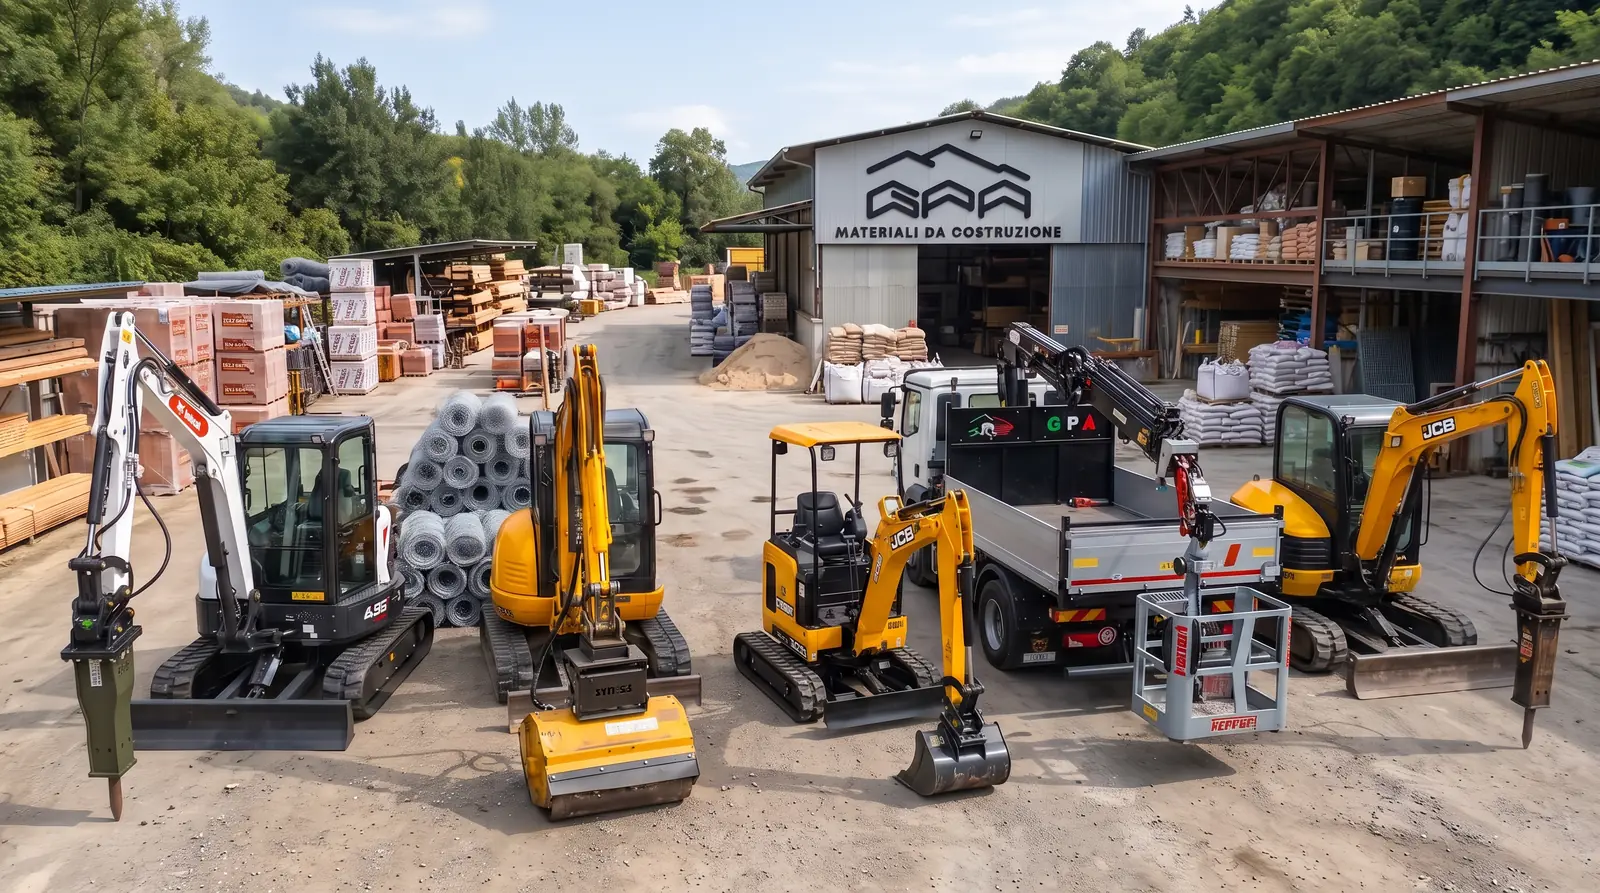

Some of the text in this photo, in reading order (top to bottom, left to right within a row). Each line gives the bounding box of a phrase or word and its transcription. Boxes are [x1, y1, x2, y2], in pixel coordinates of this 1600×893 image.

[835, 226, 1062, 239] MATERIALI DA COSTRUZIONE
[1423, 417, 1455, 439] JCB
[891, 524, 915, 550] JCB
